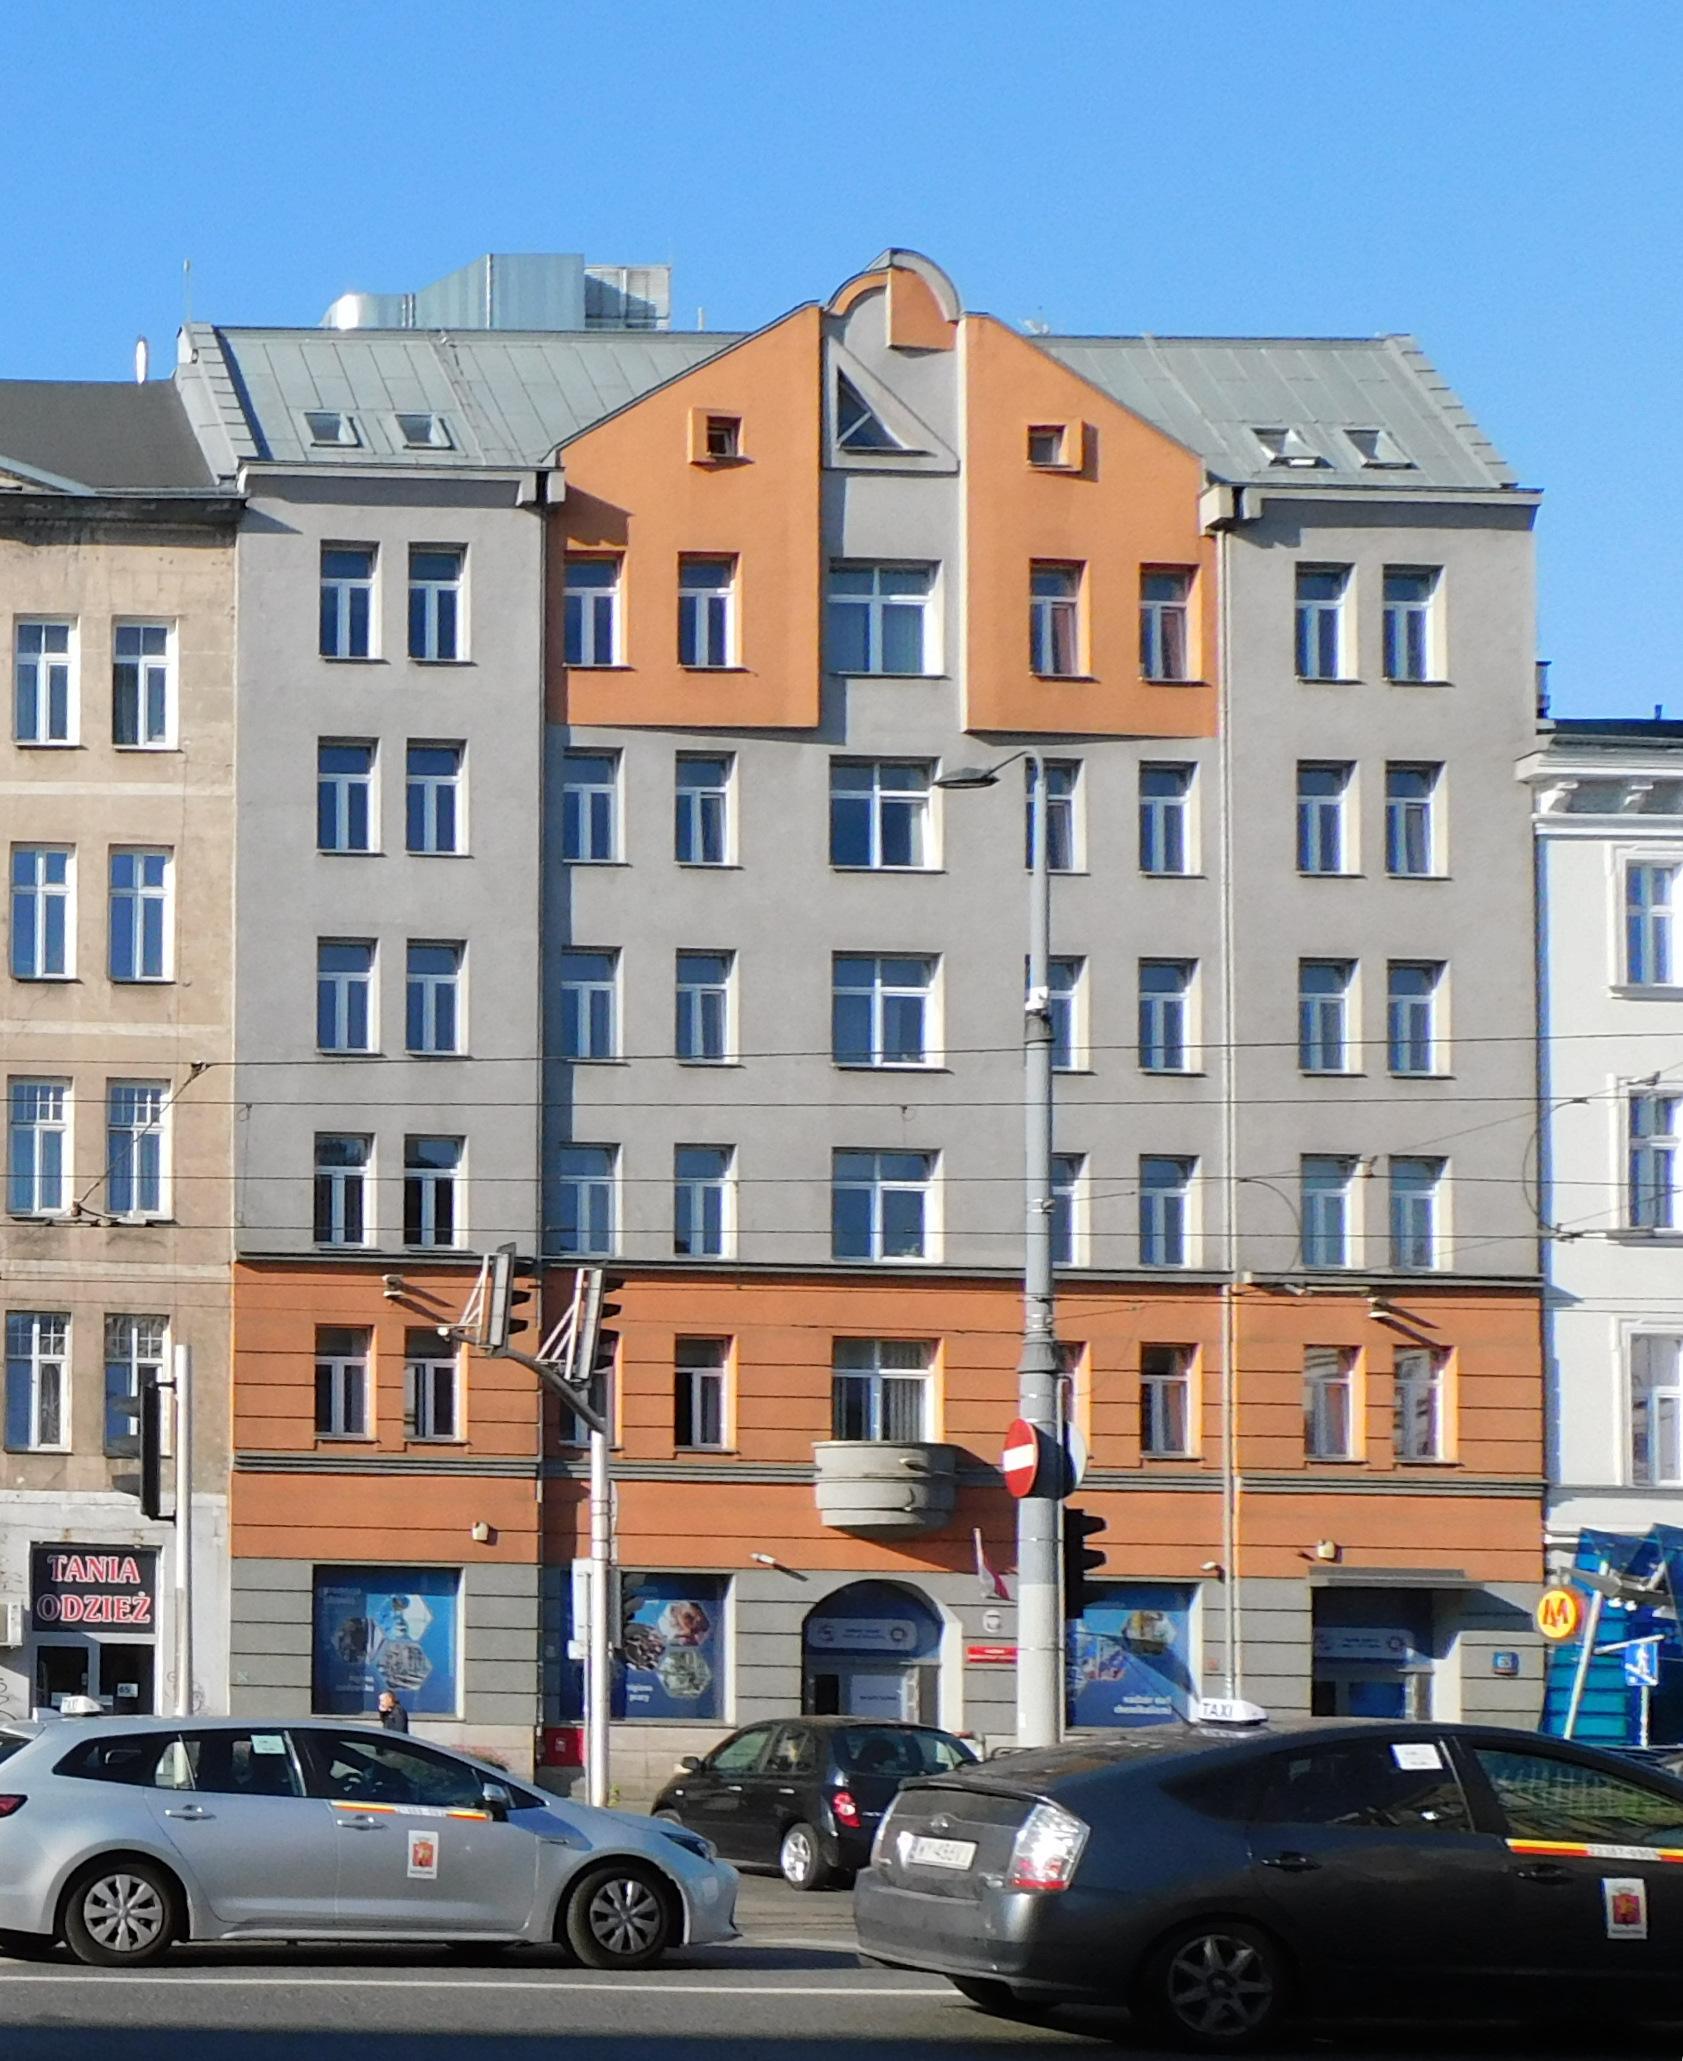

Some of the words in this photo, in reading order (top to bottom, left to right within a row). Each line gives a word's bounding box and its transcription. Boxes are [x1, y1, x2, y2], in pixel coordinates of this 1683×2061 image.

[47, 1554, 141, 1584] TANIA
[37, 1591, 151, 1623] ODZIEŻ
[1202, 1702, 1233, 1718] TAXI
